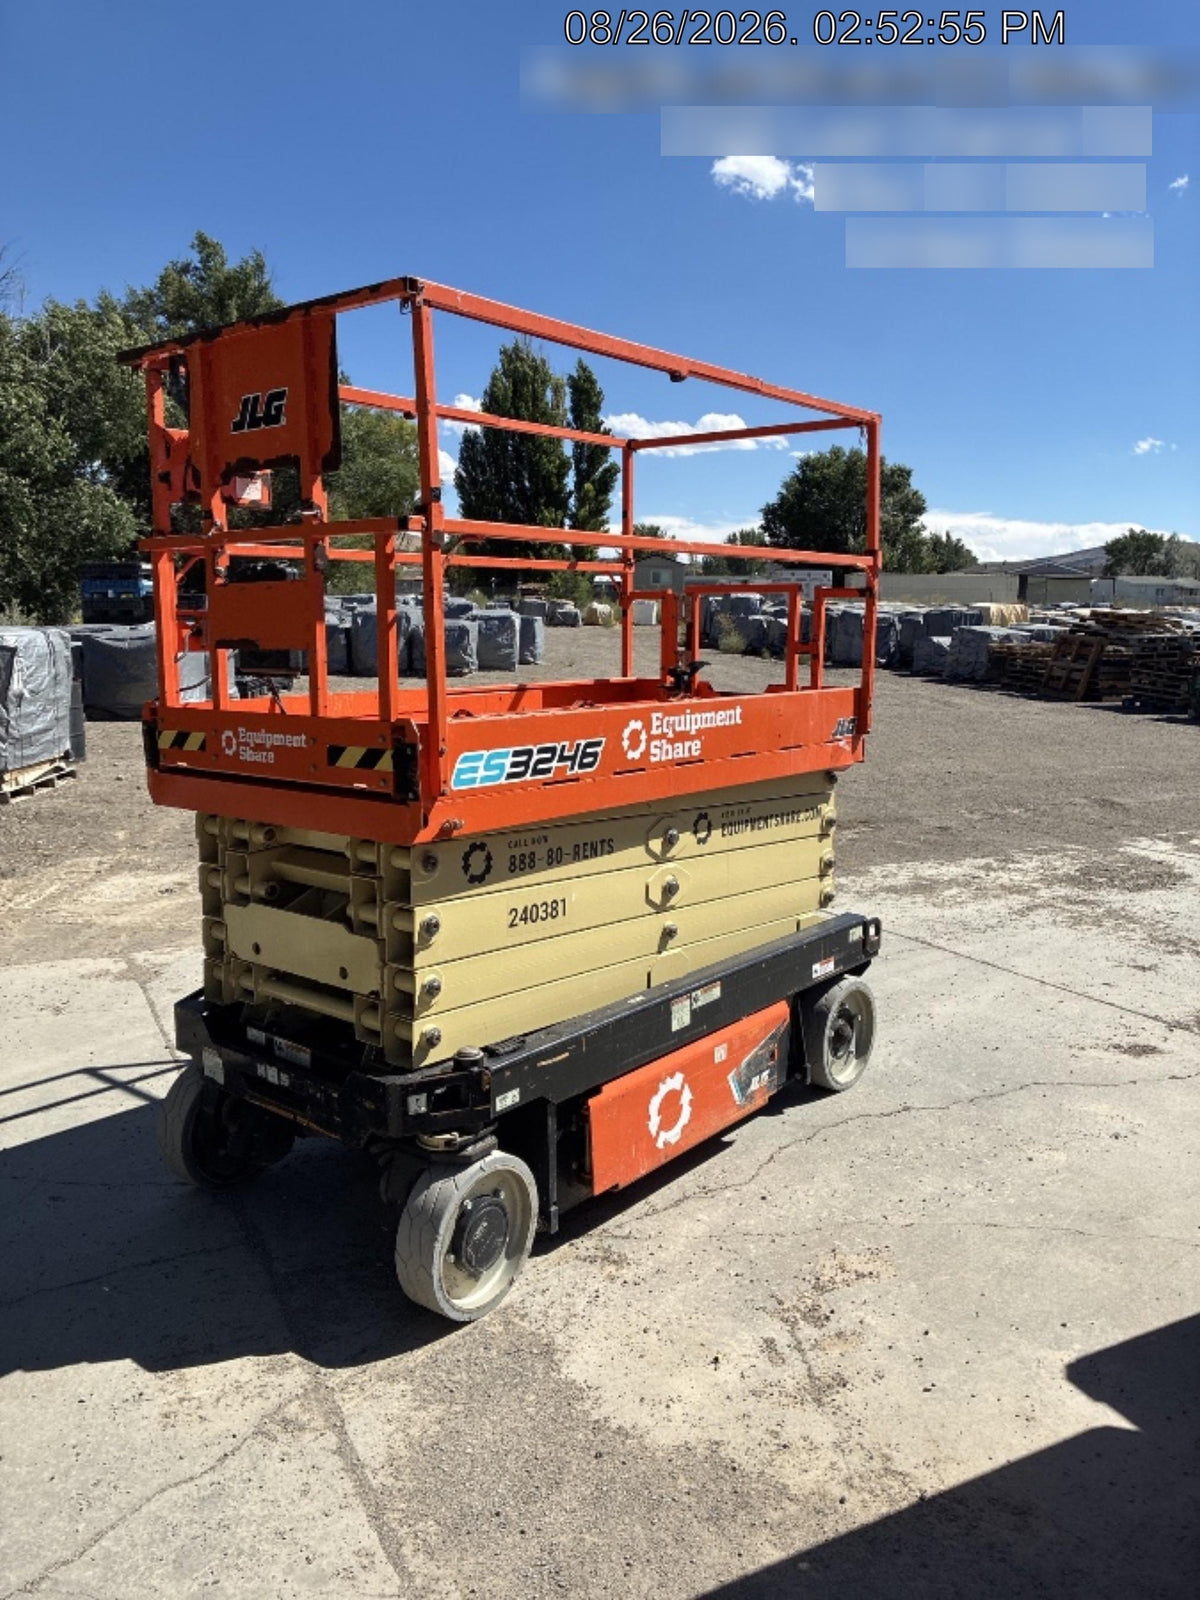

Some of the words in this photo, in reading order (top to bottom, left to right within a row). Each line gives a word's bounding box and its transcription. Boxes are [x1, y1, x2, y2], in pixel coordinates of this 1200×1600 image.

[231, 387, 288, 434] JLG
[238, 728, 307, 747] Equipment
[650, 705, 742, 738] Equipment
[238, 747, 275, 764] Share
[452, 738, 604, 789] ES3246
[650, 736, 702, 763] Share
[508, 838, 615, 874] 888-80-RENTS
[508, 897, 567, 929] 240381
